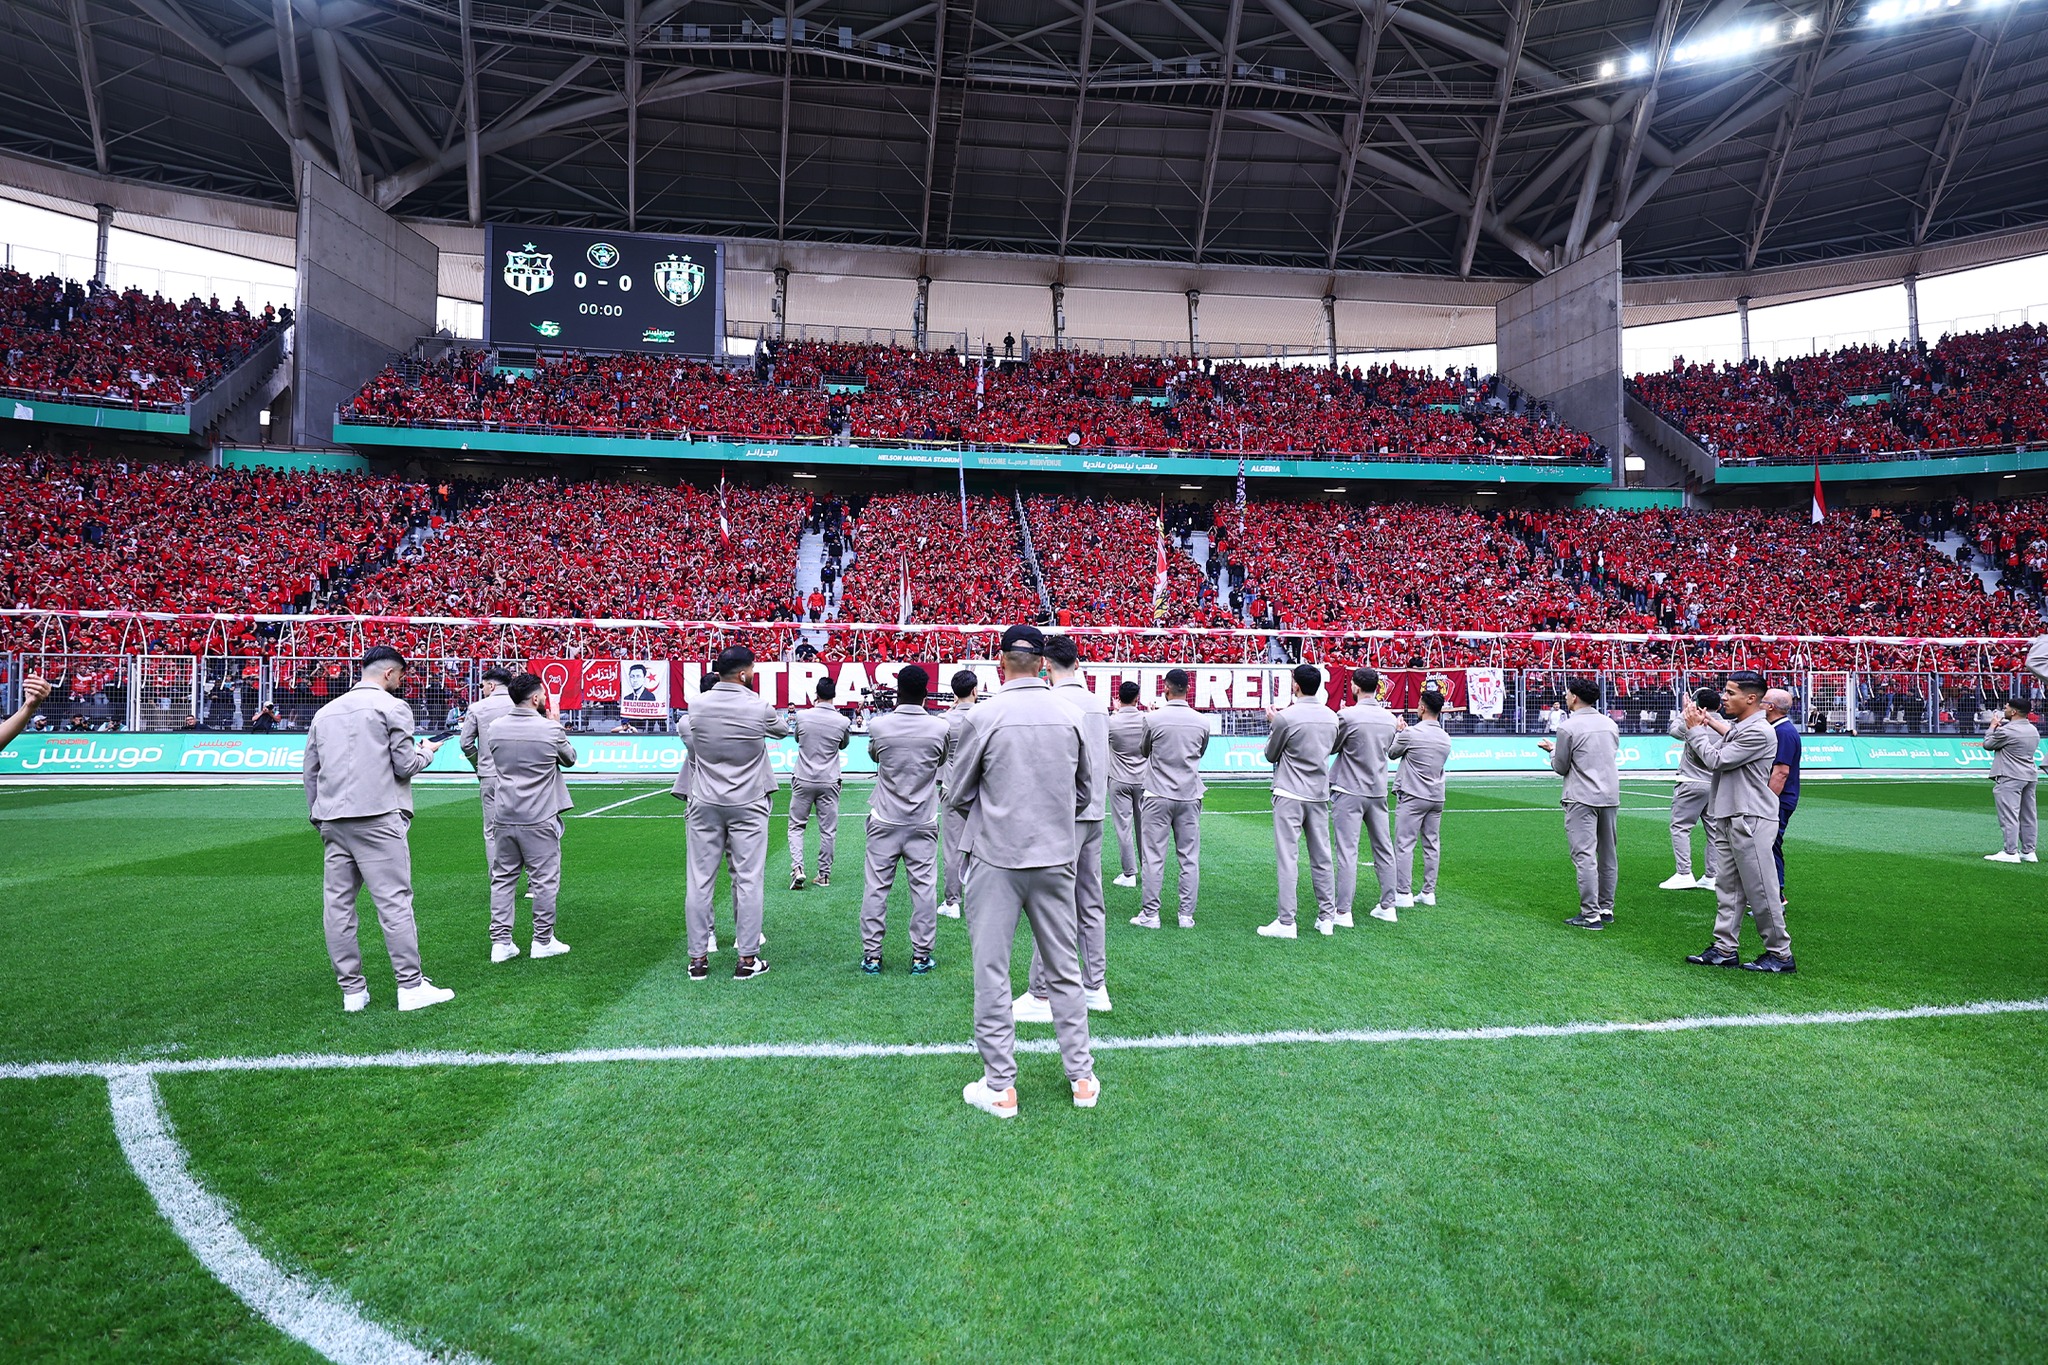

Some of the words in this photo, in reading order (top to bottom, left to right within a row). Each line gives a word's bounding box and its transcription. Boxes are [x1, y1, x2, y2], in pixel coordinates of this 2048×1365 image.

[574, 271, 587, 288] 0
[619, 274, 632, 291] 0
[579, 303, 623, 317] 00:00
[877, 454, 903, 462] NELSON
[903, 455, 933, 463] MANDELA
[977, 457, 1006, 465] WELCOME
[1029, 459, 1061, 467] BIENVENUE
[21, 740, 164, 769] موبيليس
[1804, 754, 1832, 762] Future
